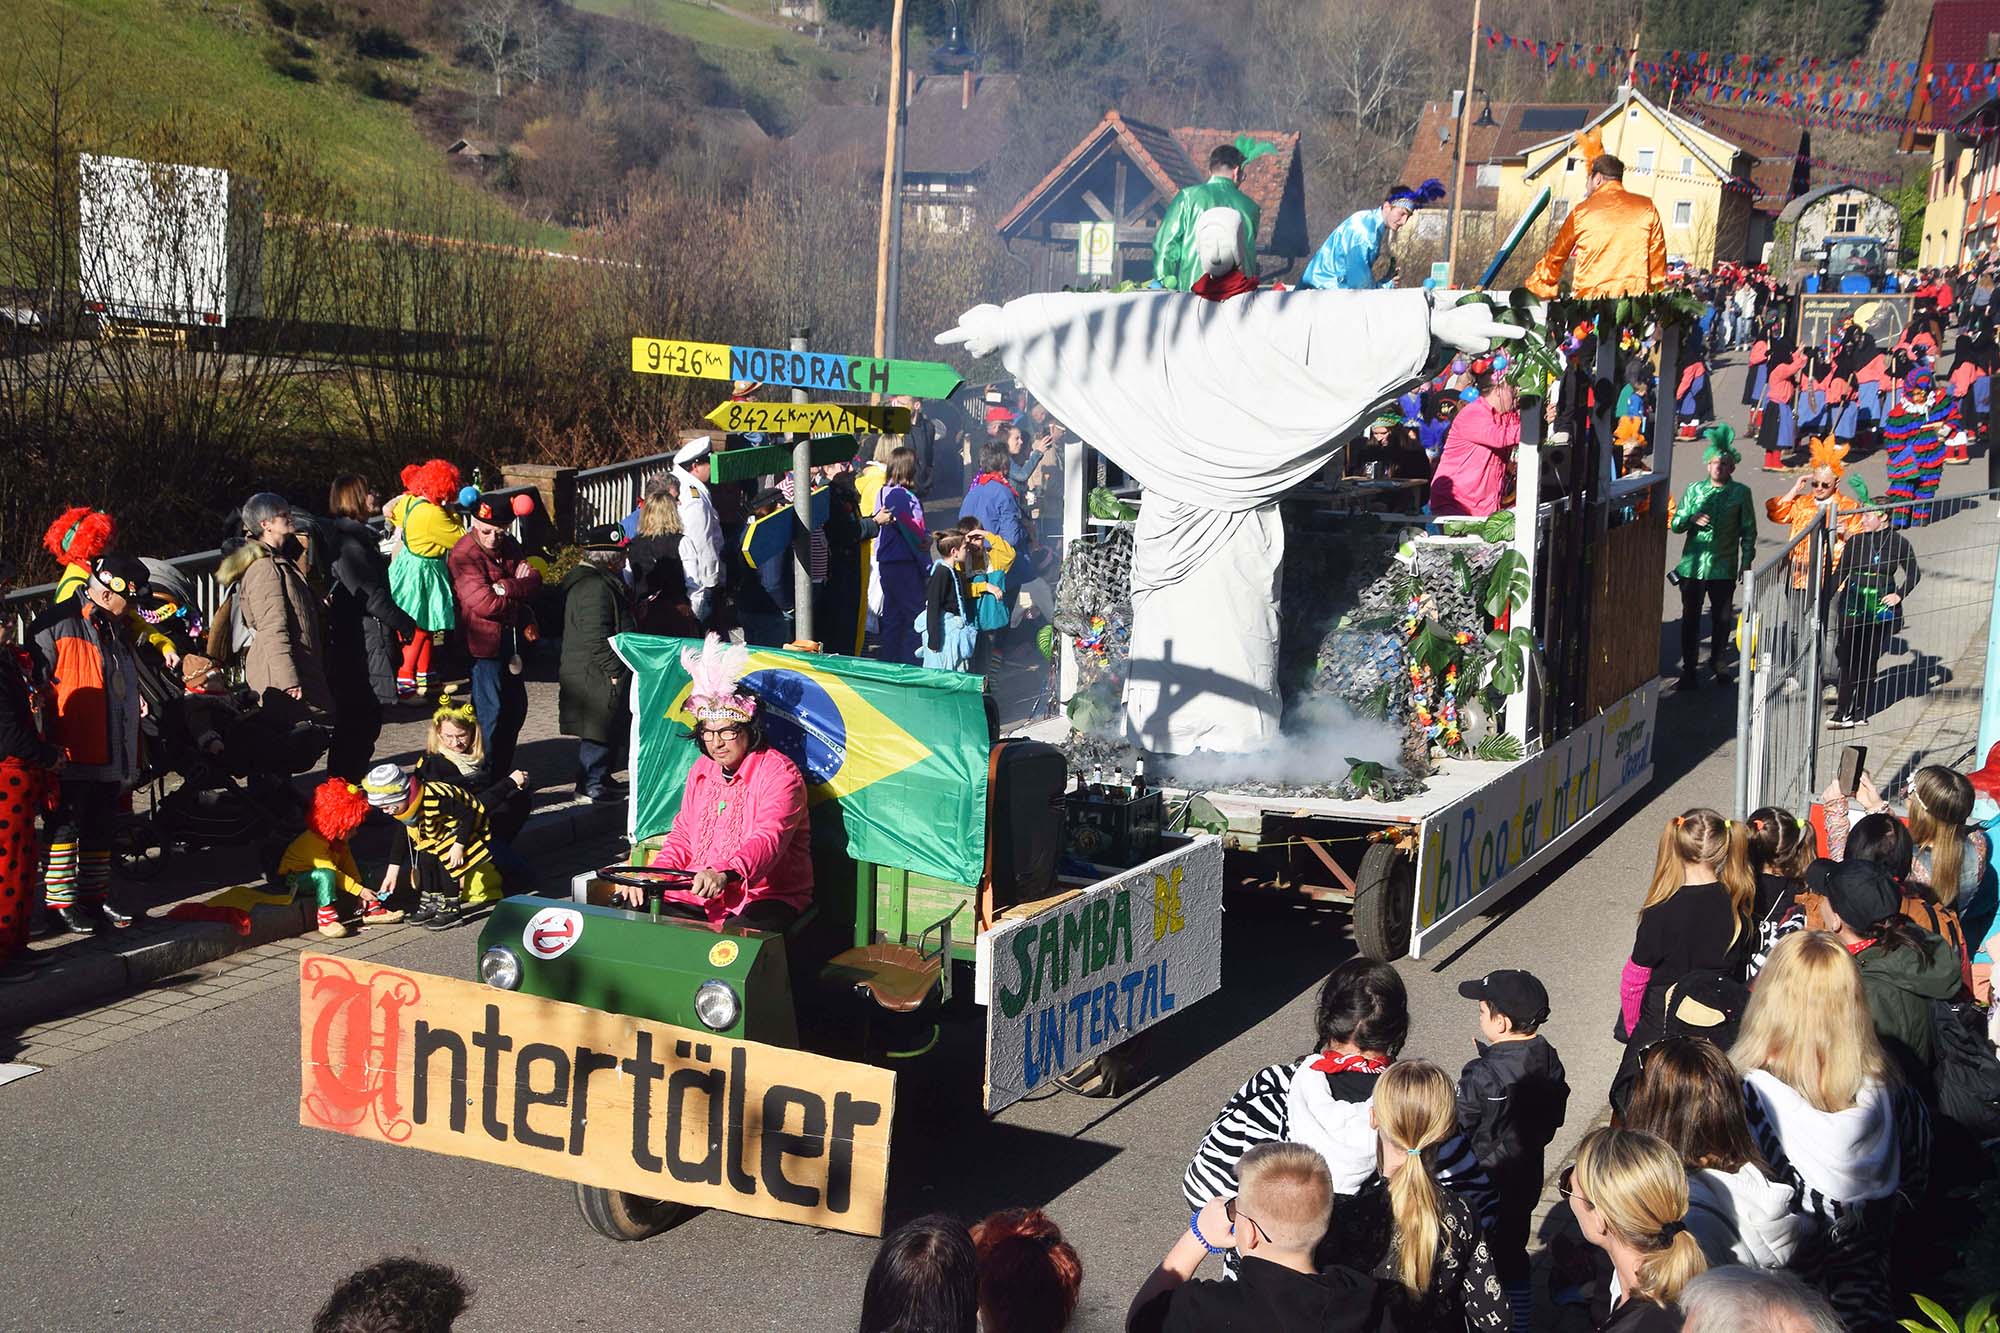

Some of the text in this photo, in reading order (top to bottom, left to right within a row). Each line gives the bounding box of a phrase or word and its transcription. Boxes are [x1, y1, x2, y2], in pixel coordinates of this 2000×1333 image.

[1000, 864, 1185, 1019] SAMBA DE
[301, 956, 882, 1214] Untertäler
[1023, 958, 1175, 1090] UNTERTAL
